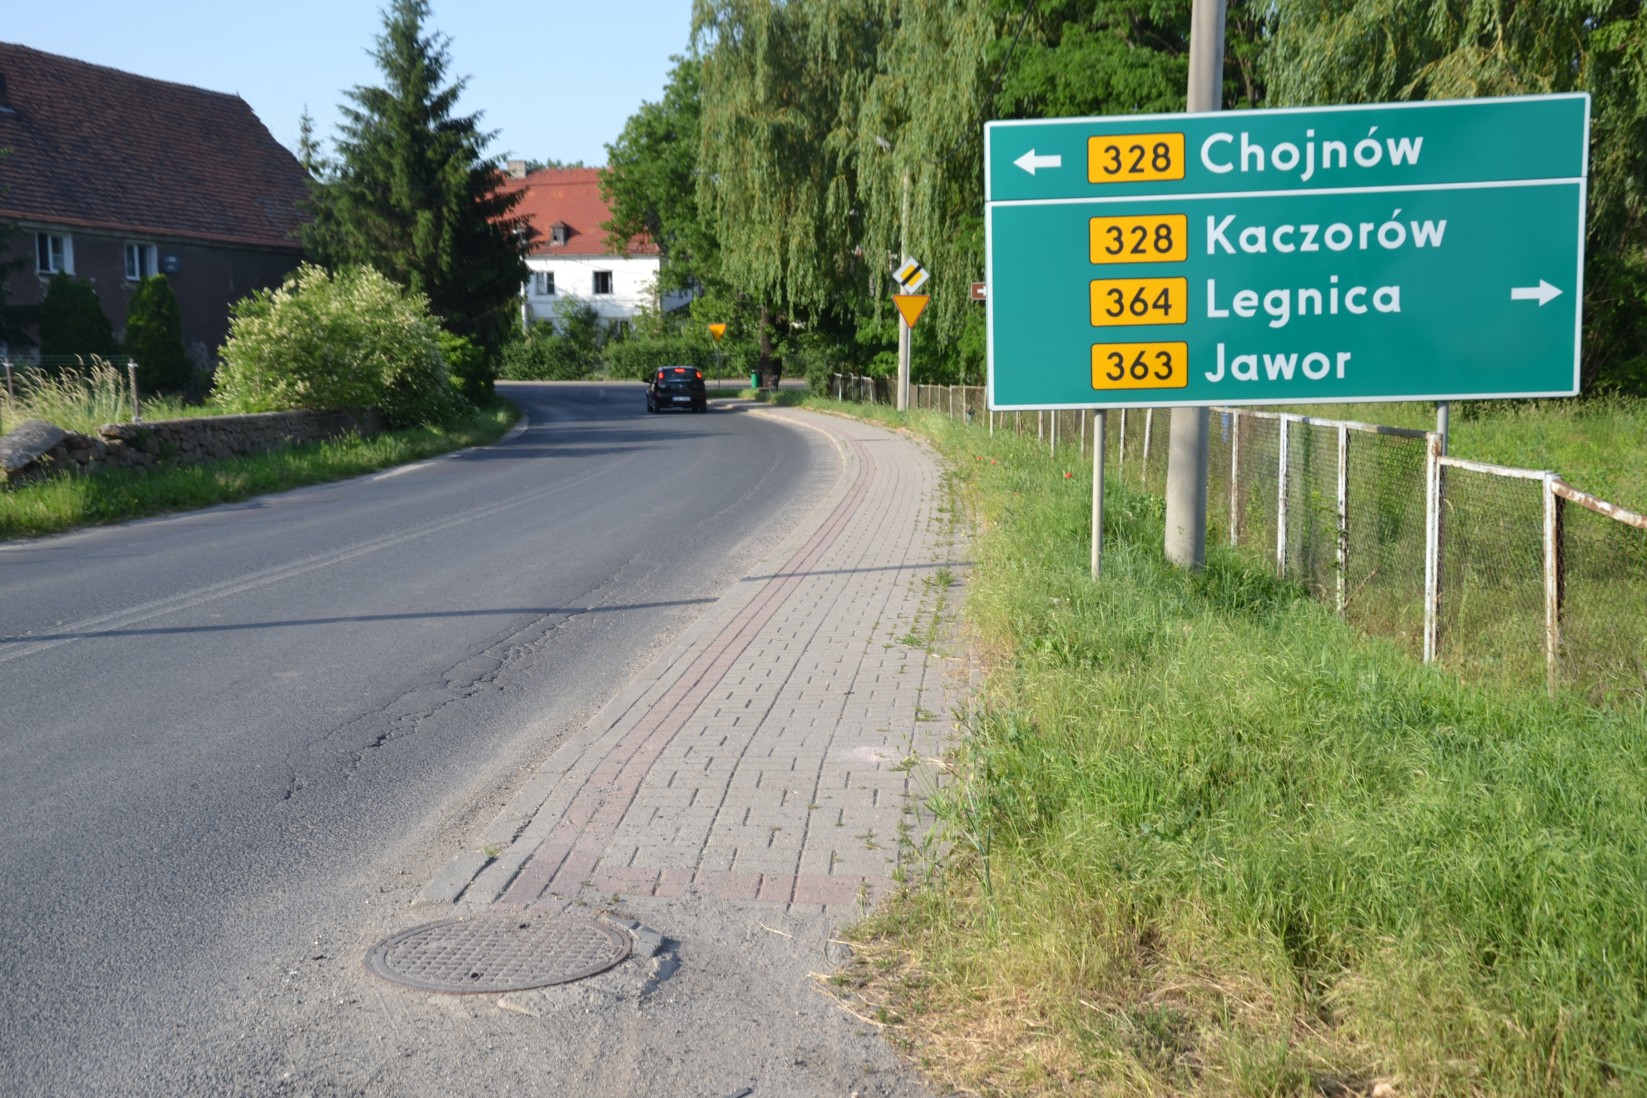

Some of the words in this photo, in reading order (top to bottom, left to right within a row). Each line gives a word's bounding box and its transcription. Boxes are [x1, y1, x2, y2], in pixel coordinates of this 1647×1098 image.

[1103, 142, 1170, 174] 328
[1200, 126, 1423, 181] Chojnów
[1105, 223, 1172, 254] 328
[1206, 208, 1446, 254] Kaczorów
[1105, 287, 1171, 317] 364
[1206, 275, 1400, 328] Legnica
[1106, 350, 1172, 381] 363
[1204, 342, 1351, 382] Jawor
